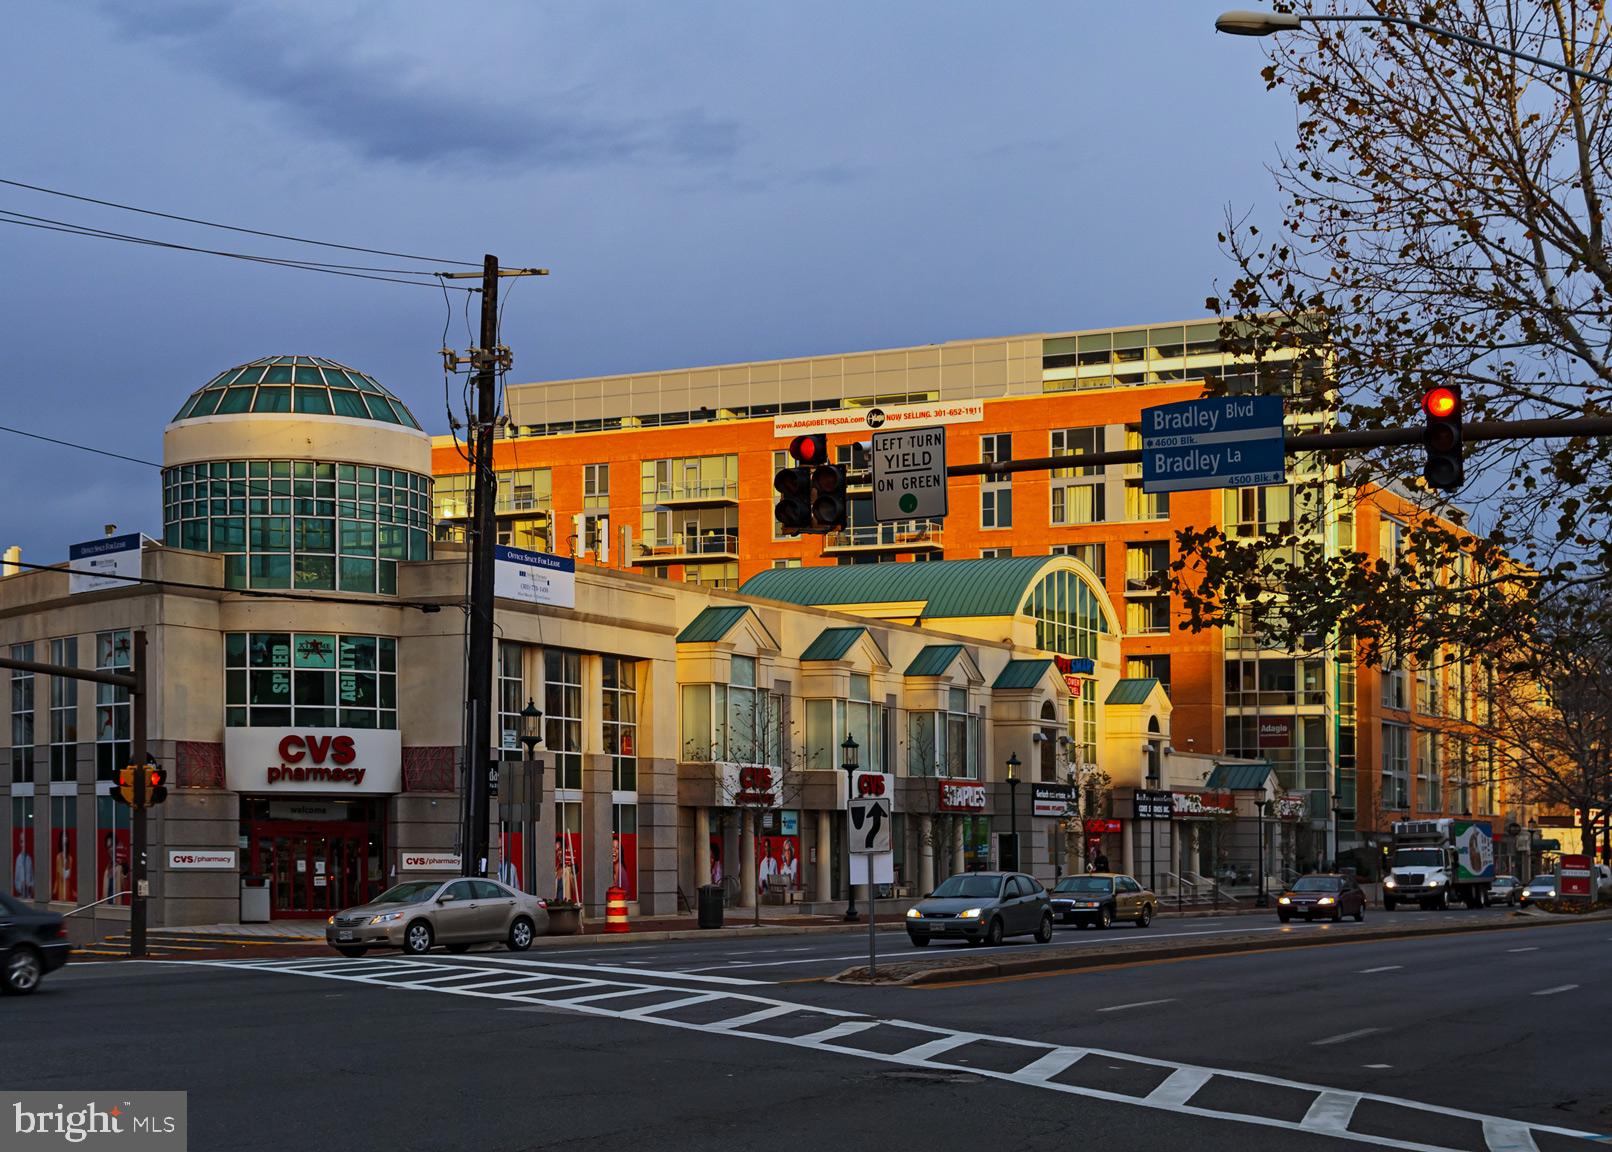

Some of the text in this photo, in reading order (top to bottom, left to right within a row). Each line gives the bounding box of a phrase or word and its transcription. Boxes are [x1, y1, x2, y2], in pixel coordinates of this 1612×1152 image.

[775, 415, 865, 430] www.ADAGIOBETHESDA.com
[886, 413, 902, 422] NOW
[933, 406, 982, 418] 301-652-1911
[1153, 400, 1254, 431] Bradley Blvd
[875, 432, 942, 452] LEFT TURN
[1154, 435, 1198, 447] 4600 Blk.
[884, 450, 933, 469] YIELD
[1155, 447, 1242, 475] Bradley La
[878, 474, 941, 492] ON GREEN
[1228, 473, 1272, 485] 4500 Blk.
[272, 644, 289, 694] SPEED
[341, 641, 356, 702] AGILITY
[1260, 723, 1288, 734] Adagio
[278, 734, 357, 765] CVS
[267, 763, 367, 786] pharmacy
[739, 766, 774, 791] CVS
[857, 773, 886, 796] CVS
[943, 784, 986, 807] STAPLES
[290, 806, 327, 814] welcome
[173, 855, 231, 864] CVS/pharmacy
[405, 856, 461, 866] CVS/pharmacy
